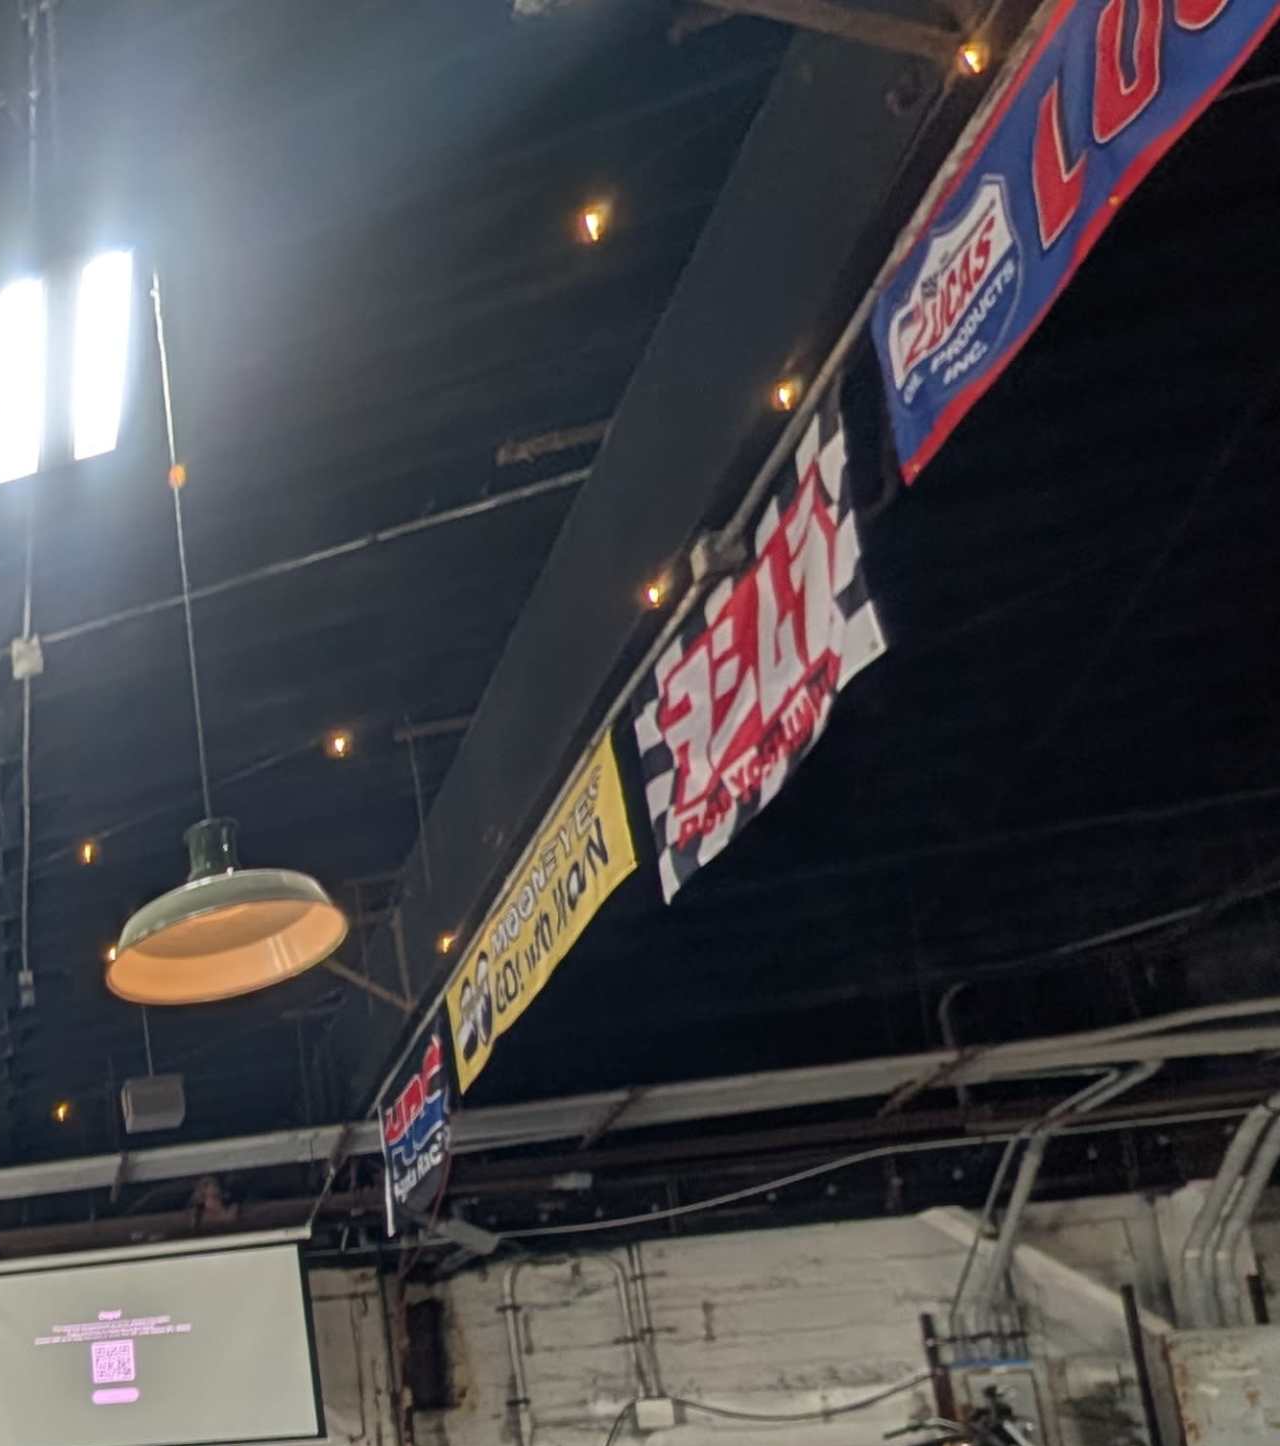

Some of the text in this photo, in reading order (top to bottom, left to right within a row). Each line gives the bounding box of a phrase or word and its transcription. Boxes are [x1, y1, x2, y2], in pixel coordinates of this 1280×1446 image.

[1031, 0, 1230, 250] LU
[902, 215, 996, 371] LUCAS
[930, 257, 1016, 375] PRODUCTS
